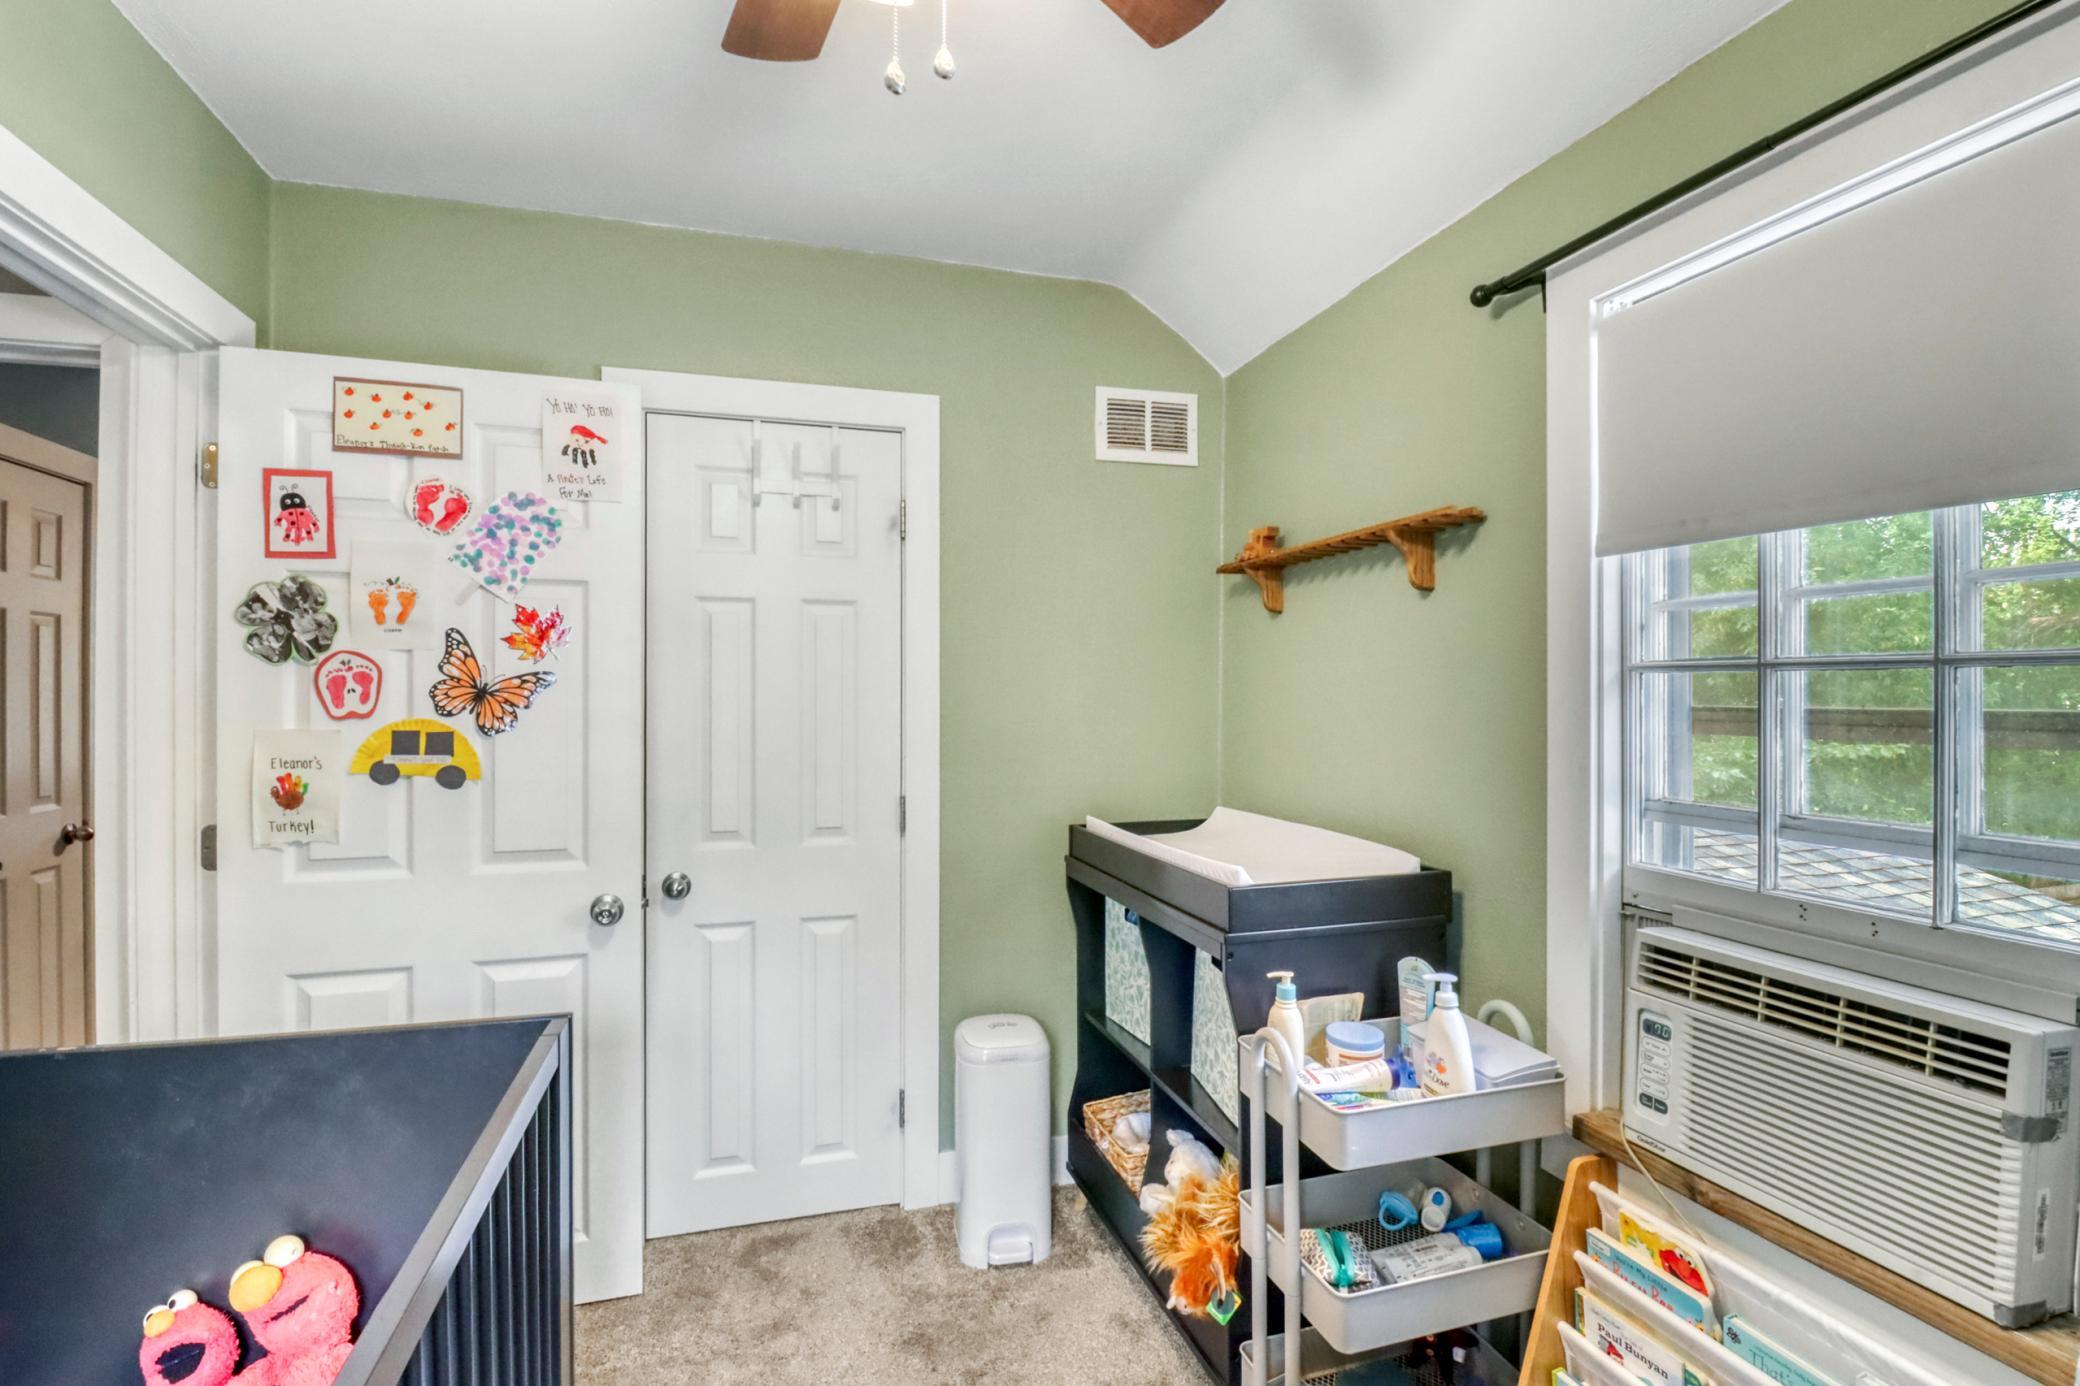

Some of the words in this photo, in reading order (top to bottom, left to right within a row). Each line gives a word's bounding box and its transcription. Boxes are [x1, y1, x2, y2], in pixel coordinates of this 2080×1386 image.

[270, 756, 323, 771] Eleanor's
[1597, 1322, 1623, 1347] Paul
[1624, 1341, 1669, 1380] Bunyan
